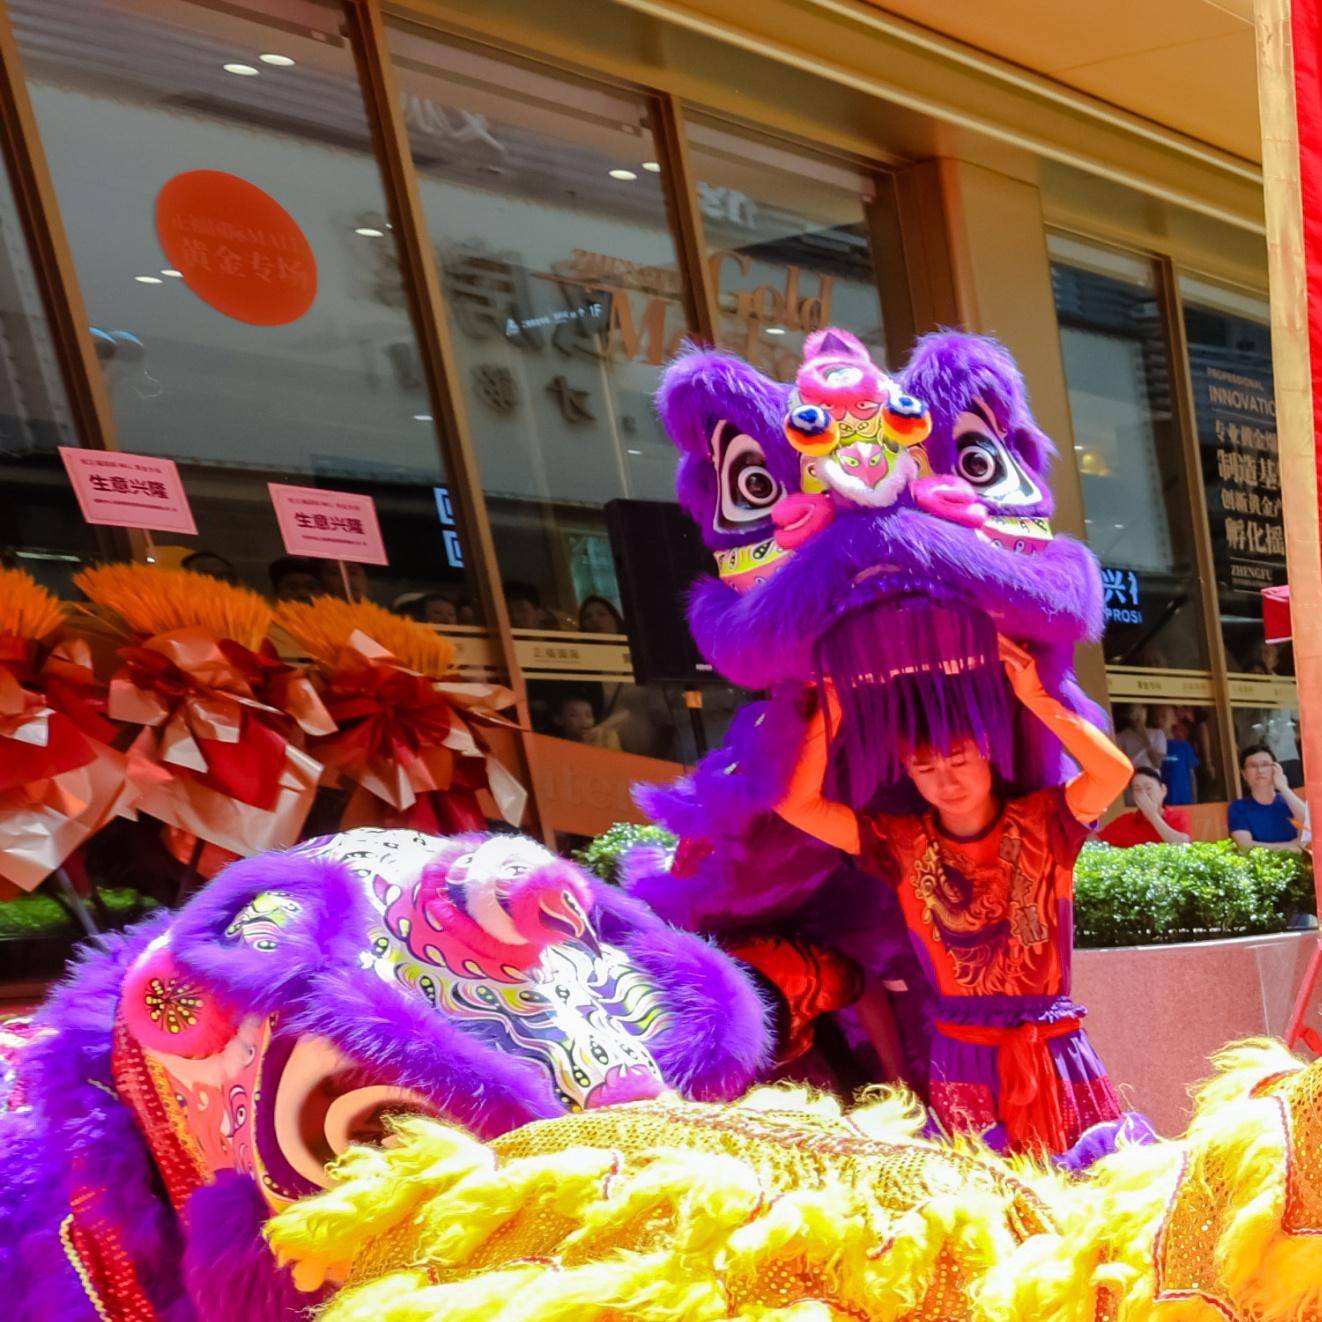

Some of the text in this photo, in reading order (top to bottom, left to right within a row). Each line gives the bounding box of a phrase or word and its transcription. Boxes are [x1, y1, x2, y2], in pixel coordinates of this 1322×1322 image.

[88, 473, 169, 500] 生意兴隆
[294, 512, 366, 535] 生意兴隆
